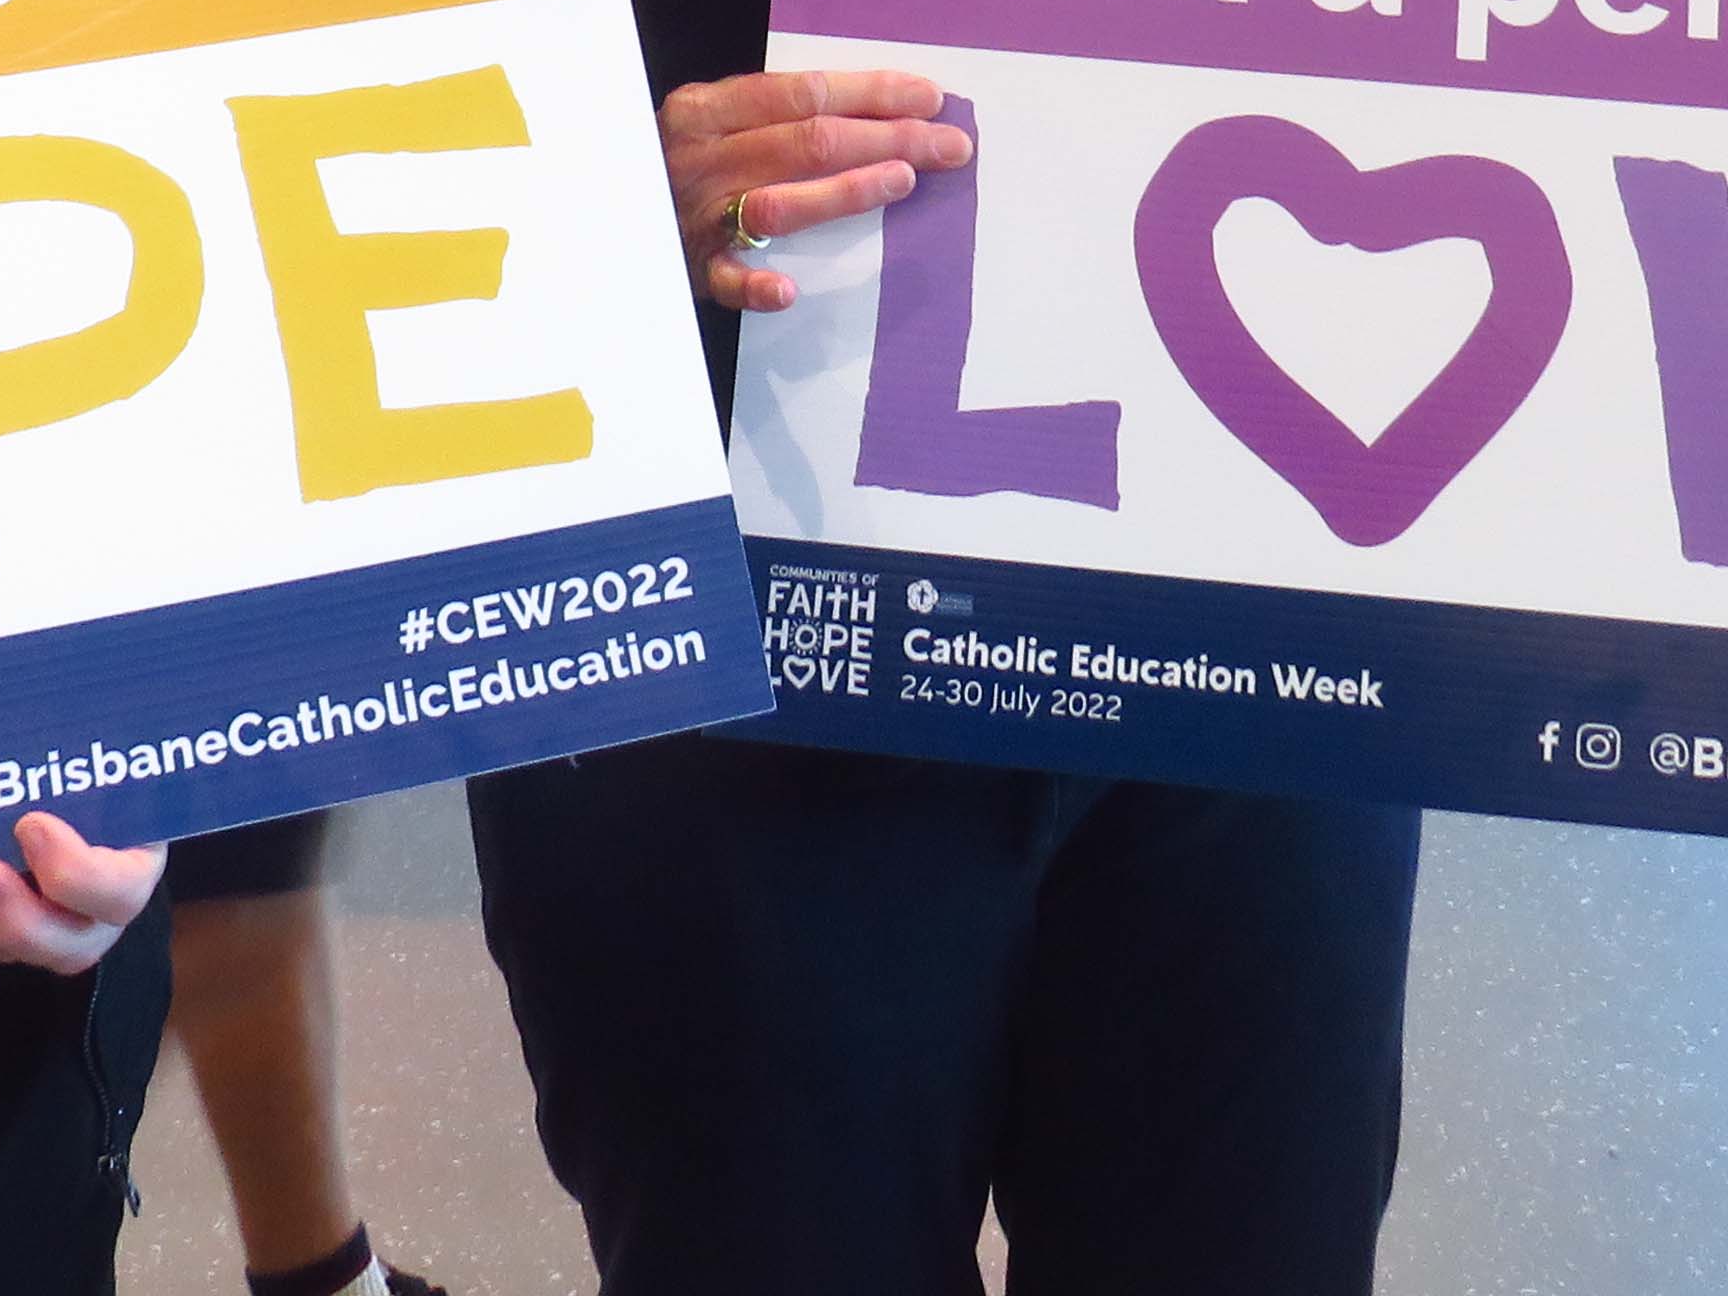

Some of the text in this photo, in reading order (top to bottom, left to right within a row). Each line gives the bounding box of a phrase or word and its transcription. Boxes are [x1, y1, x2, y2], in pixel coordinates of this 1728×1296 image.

[769, 563, 881, 587] COMMUNITIES OF
[399, 557, 694, 654] #CEW2022
[767, 580, 876, 623] FAITH
[762, 616, 874, 661] HOPE
[903, 628, 1384, 708] Catholic Education Week
[900, 674, 1122, 721] 24-30 July 2022
